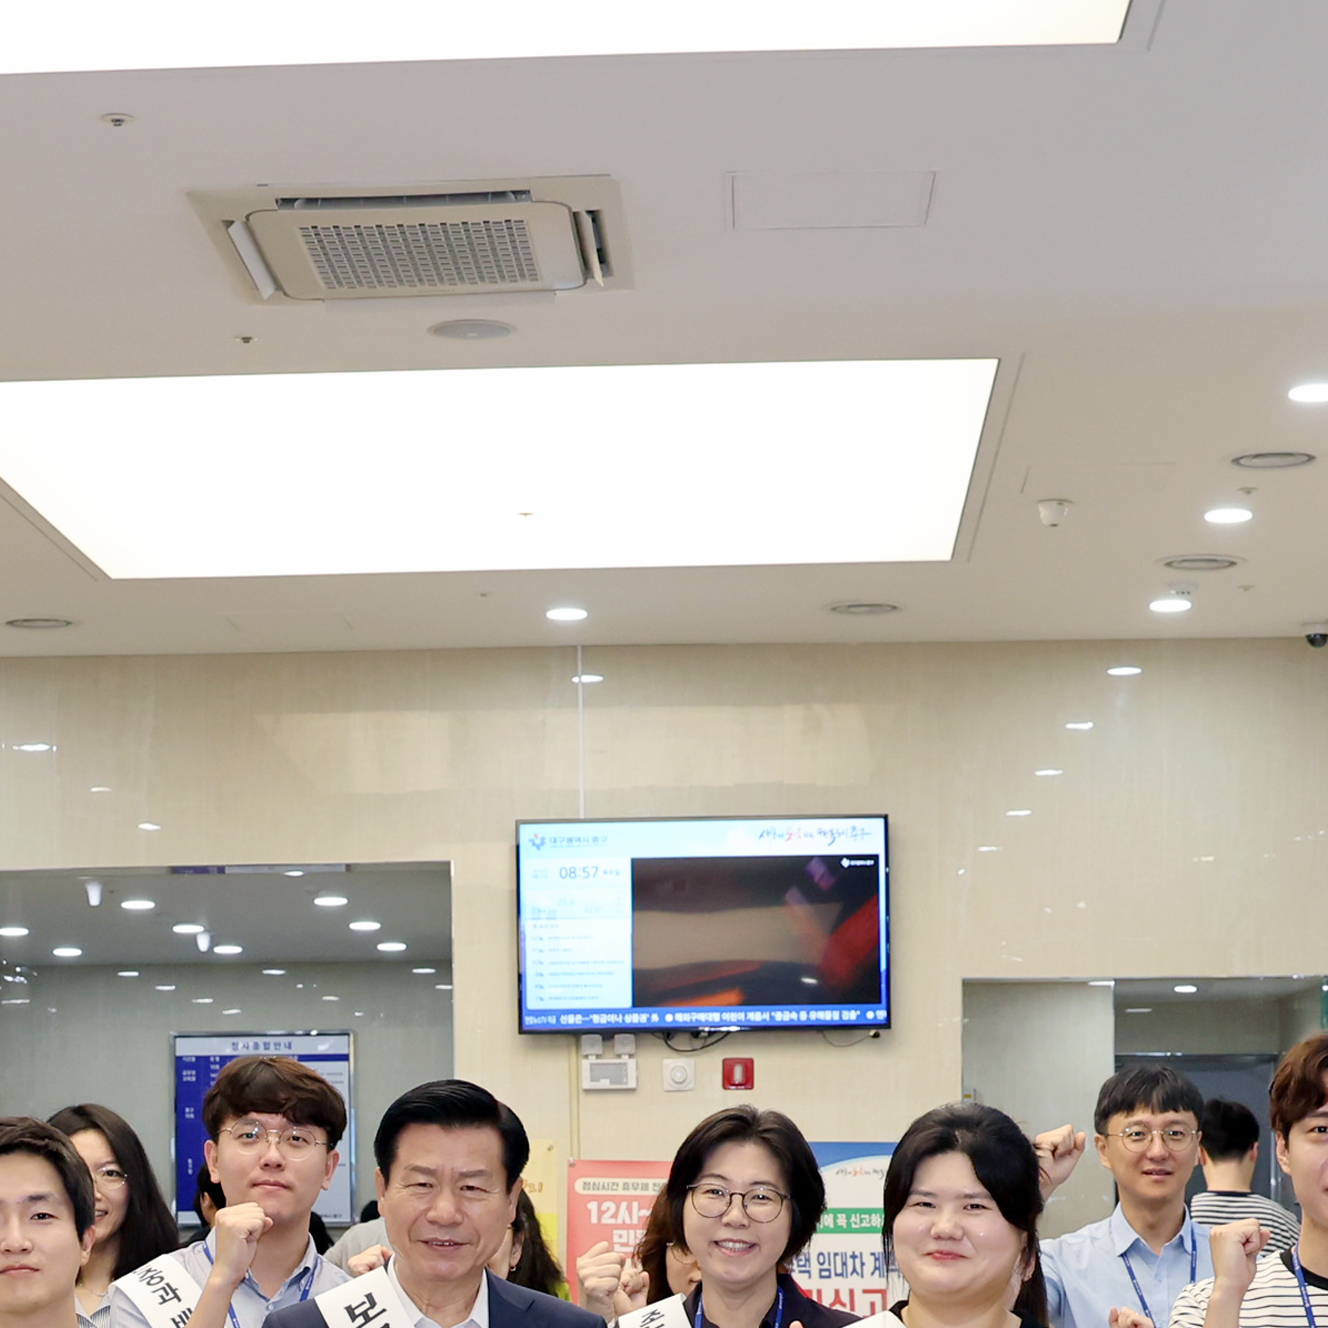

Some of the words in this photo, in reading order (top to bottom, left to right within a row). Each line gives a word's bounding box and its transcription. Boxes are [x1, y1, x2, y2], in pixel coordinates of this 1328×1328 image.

[559, 866, 599, 879] 08:57
[582, 1181, 619, 1192] 점심시간
[622, 1181, 649, 1191] 휴무제
[586, 1200, 651, 1225] 12시~
[837, 1213, 847, 1228] 꼭
[817, 1251, 866, 1279] 임대차
